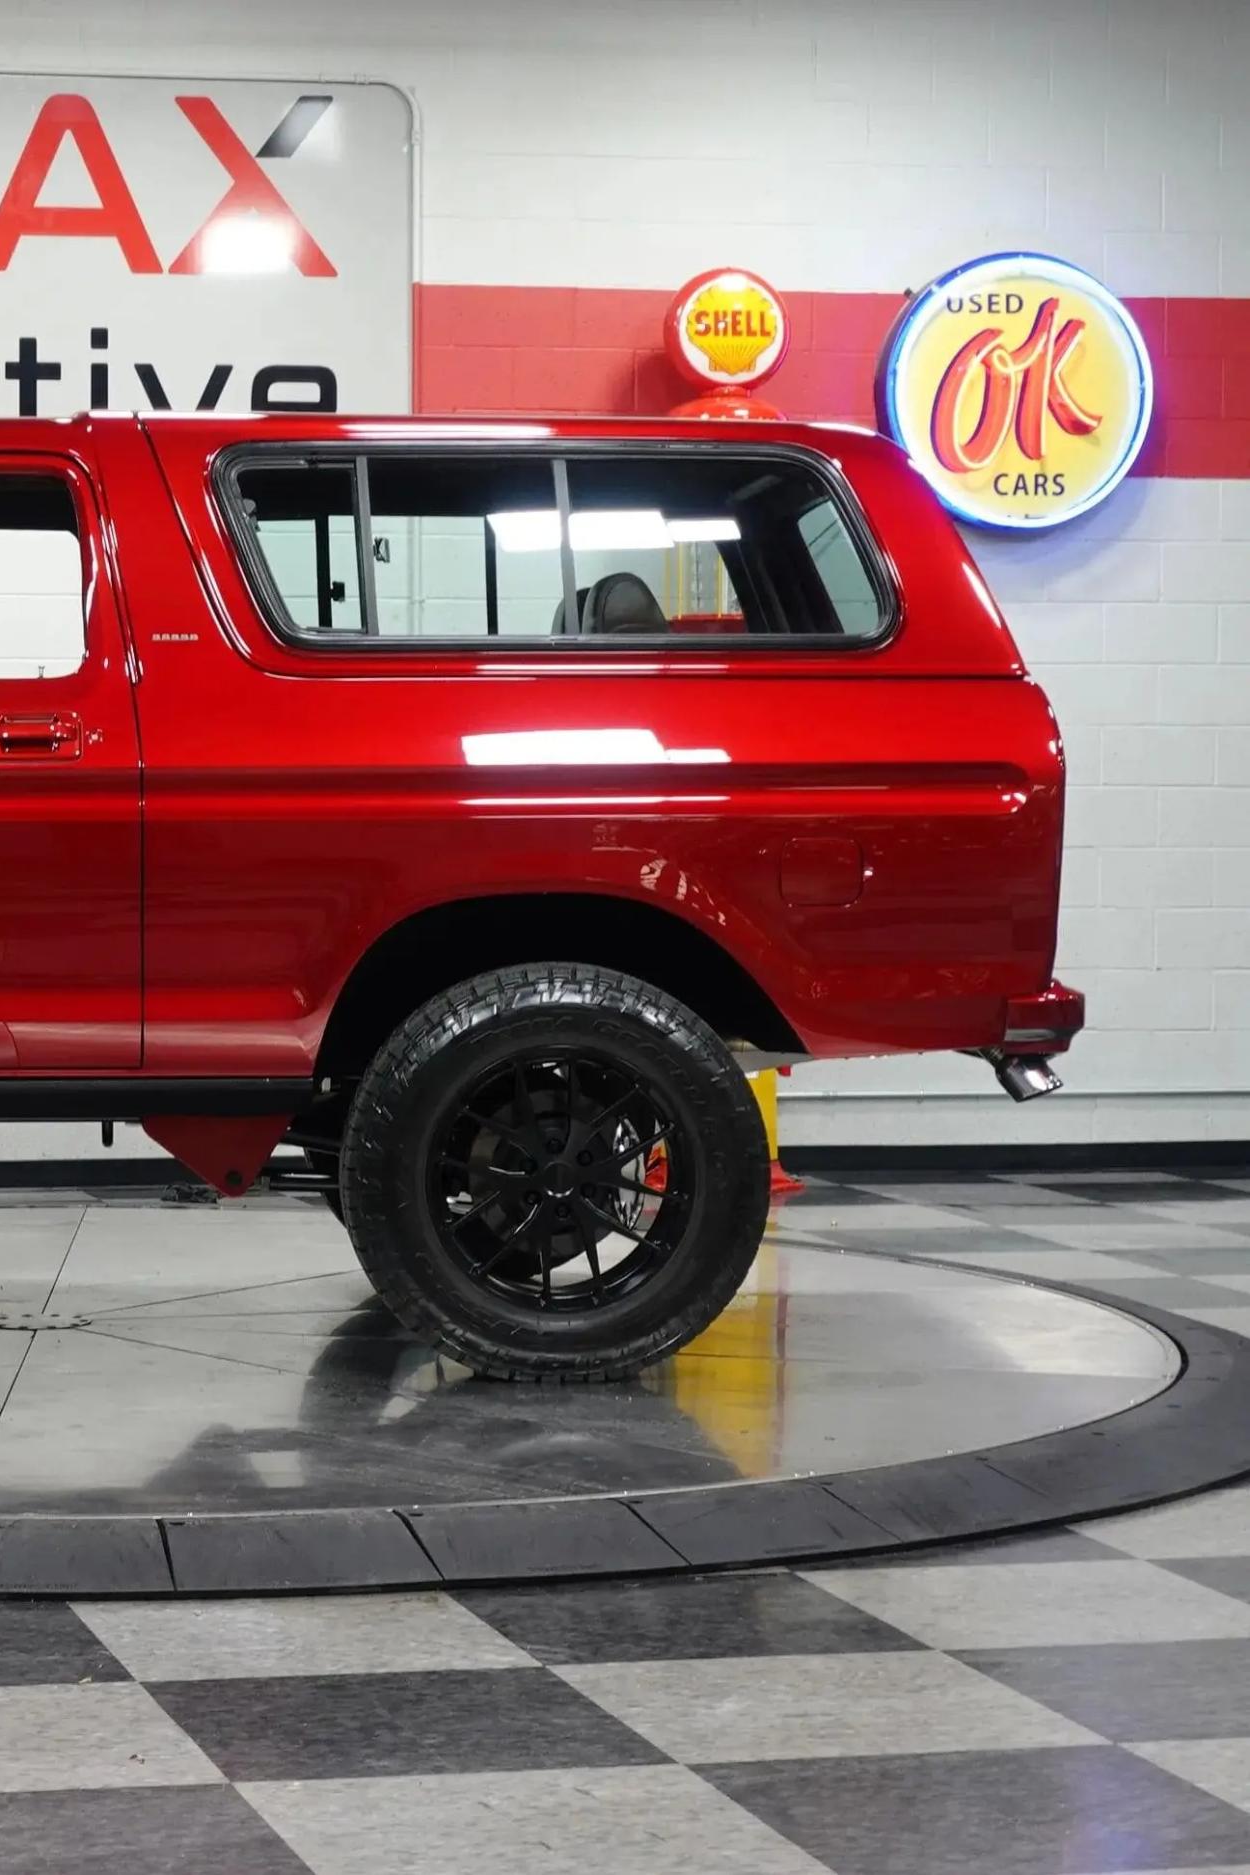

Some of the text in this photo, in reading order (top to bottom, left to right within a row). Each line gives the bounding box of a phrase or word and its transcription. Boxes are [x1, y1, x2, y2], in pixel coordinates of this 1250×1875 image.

[946, 293, 1024, 314] USED
[694, 310, 772, 337] SHELL
[929, 296, 1103, 474] OK
[993, 473, 1066, 496] CARS
